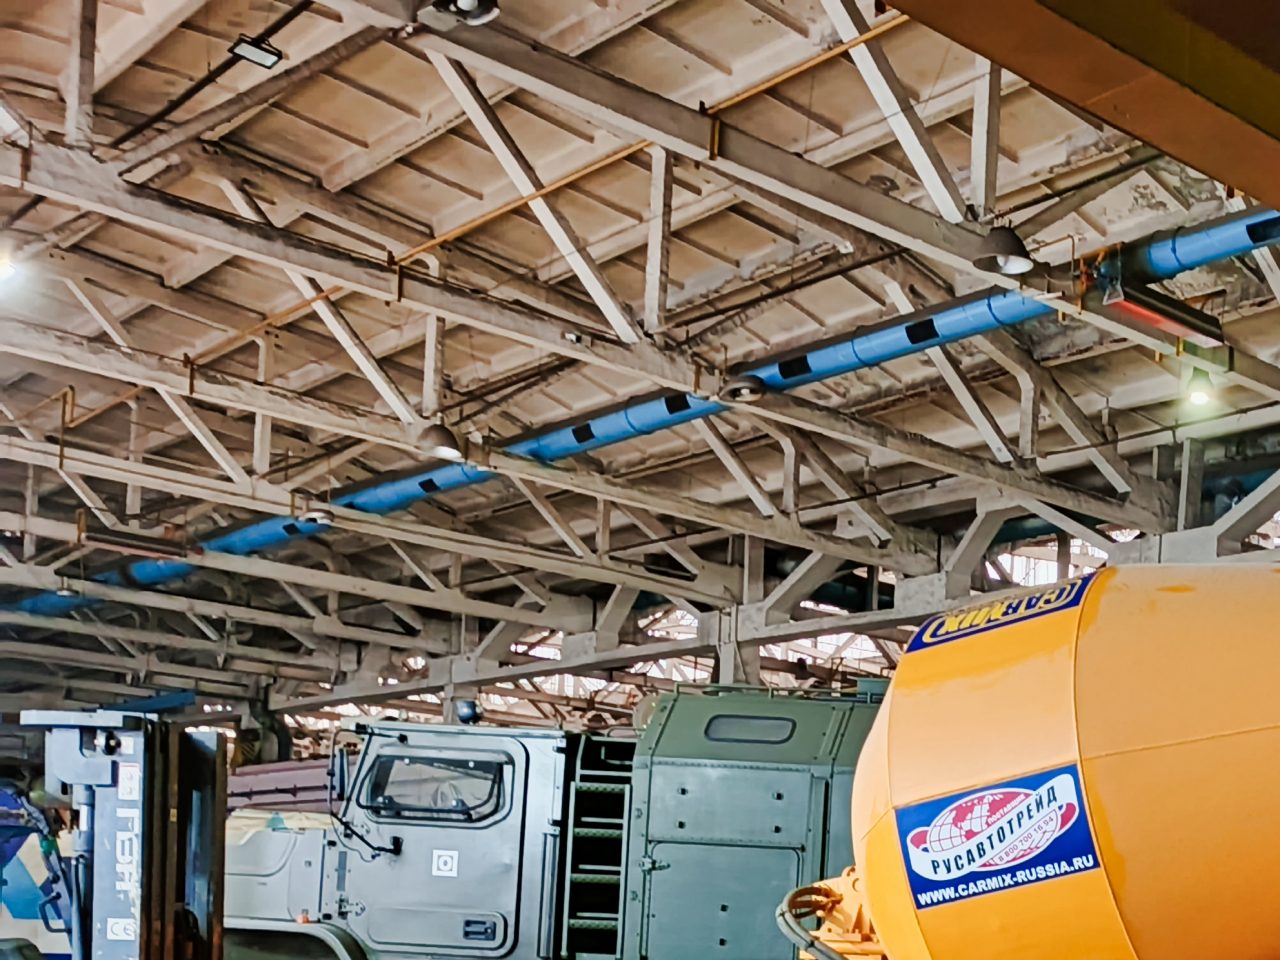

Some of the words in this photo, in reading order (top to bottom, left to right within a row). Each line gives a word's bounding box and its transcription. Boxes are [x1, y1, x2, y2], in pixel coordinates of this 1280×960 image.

[931, 785, 1058, 876] РУСАВТОТРЕЙД
[1004, 844, 1019, 857] 800
[1020, 834, 1033, 846] 700
[1034, 825, 1044, 834] 16
[1043, 816, 1054, 828] 94
[917, 853, 1095, 906] WWW.CARMIX-RUSSIA.RU
